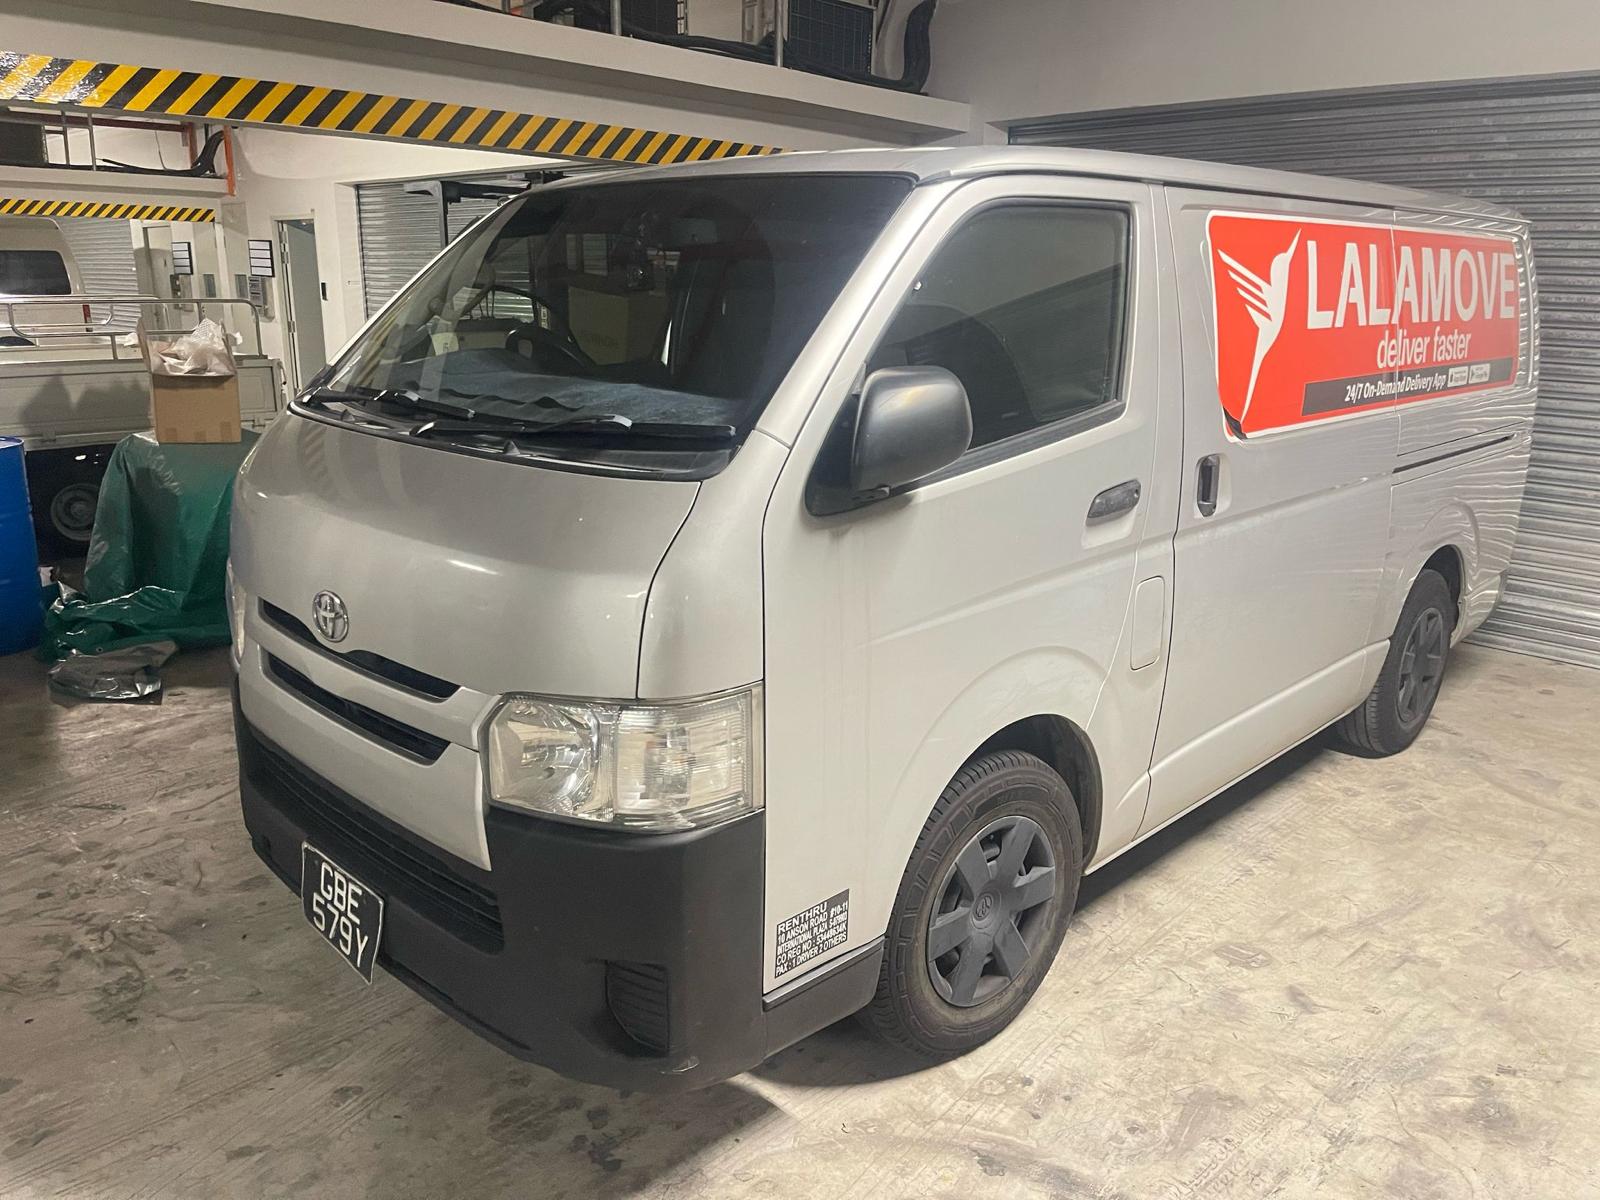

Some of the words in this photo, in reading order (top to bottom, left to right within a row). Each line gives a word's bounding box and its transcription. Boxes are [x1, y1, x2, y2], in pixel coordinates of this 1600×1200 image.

[1306, 240, 1515, 329] LALAMOVE
[1376, 329, 1431, 369] deliver
[1432, 326, 1472, 362] faster
[1344, 383, 1364, 403] 24/7
[1363, 376, 1406, 398] On-Demand
[1405, 373, 1433, 392] Delivery
[1432, 373, 1447, 390] App
[320, 861, 363, 925] GBE
[313, 891, 369, 968] 579Y
[778, 902, 827, 935] RENTHRU
[778, 934, 785, 945] 10
[786, 922, 808, 941] ANSON
[810, 912, 828, 928] ROAD
[776, 962, 788, 976] PAX
[797, 946, 818, 965] DRIVER
[824, 931, 847, 950] OTHERS
[777, 954, 786, 966] CO
[787, 946, 801, 960] REG
